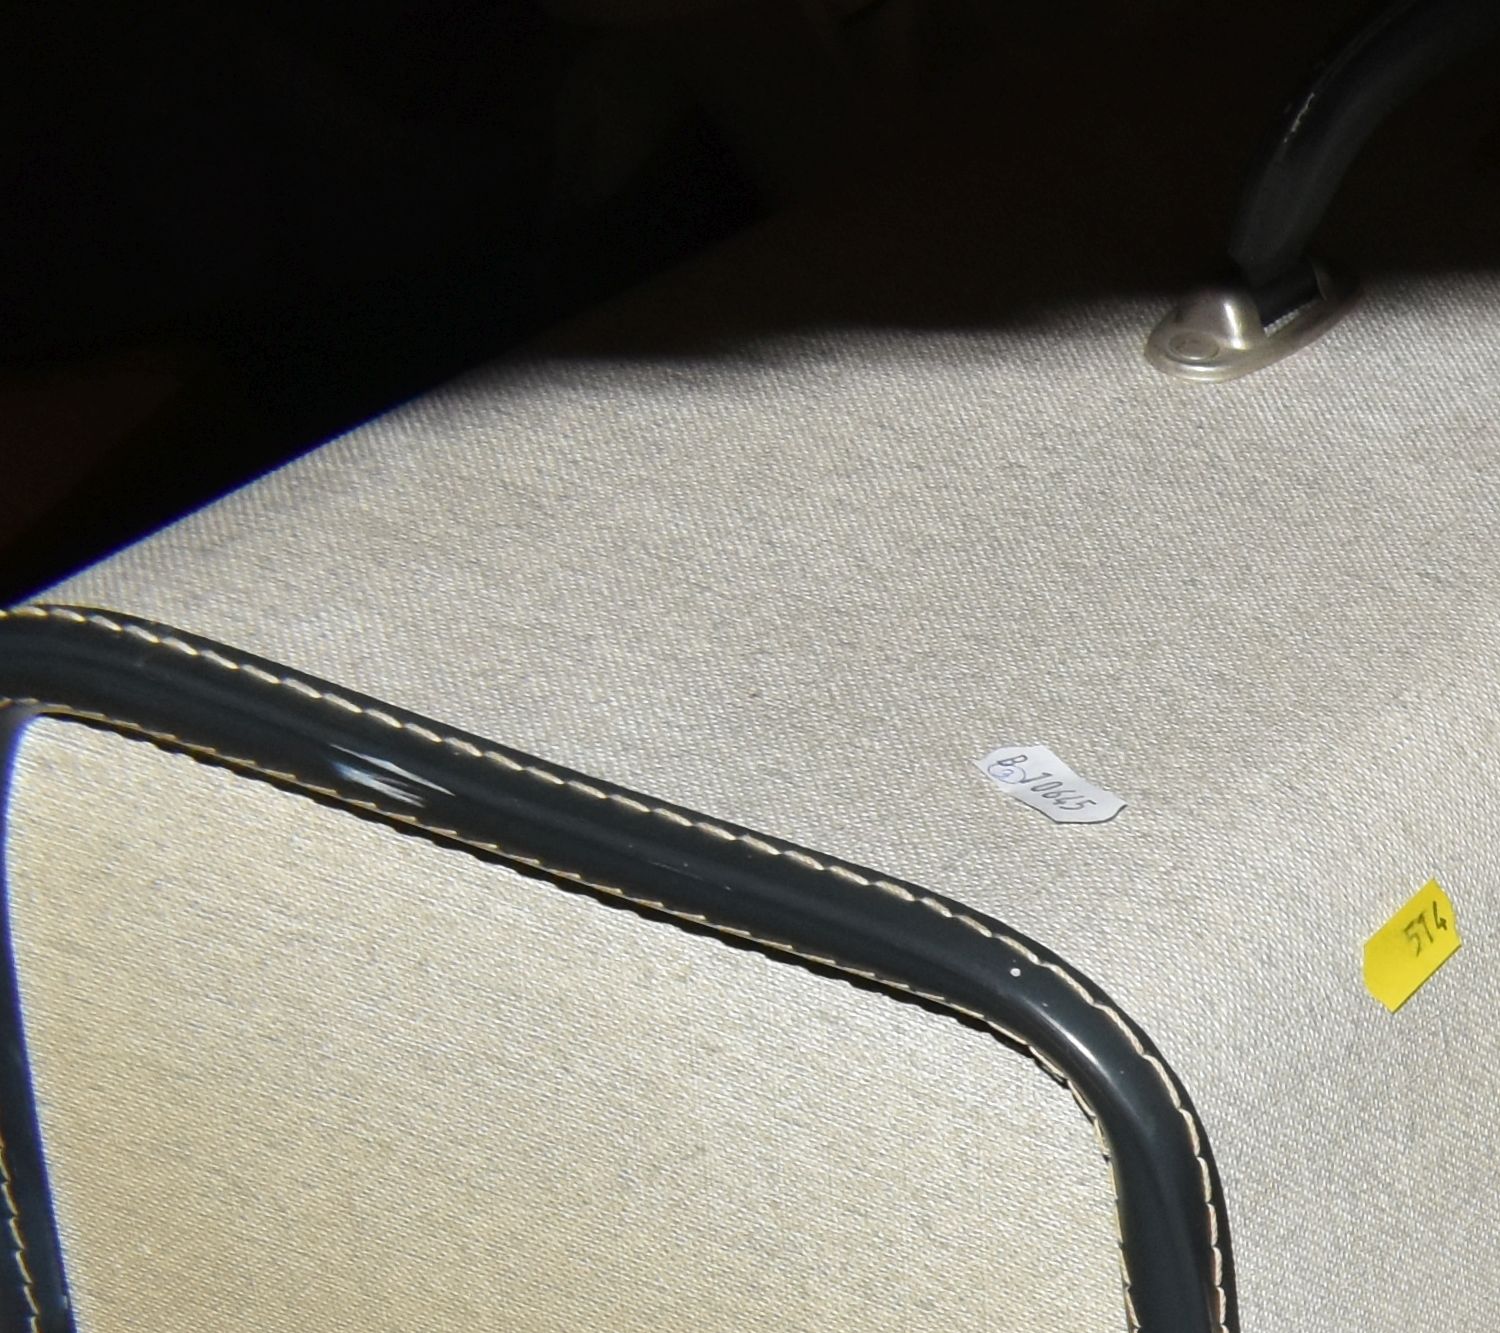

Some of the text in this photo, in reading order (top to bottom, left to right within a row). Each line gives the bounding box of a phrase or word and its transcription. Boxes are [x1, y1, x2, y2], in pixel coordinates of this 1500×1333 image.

[996, 753, 1028, 768] B
[1019, 771, 1098, 811] 10645
[1404, 900, 1449, 957] 514
